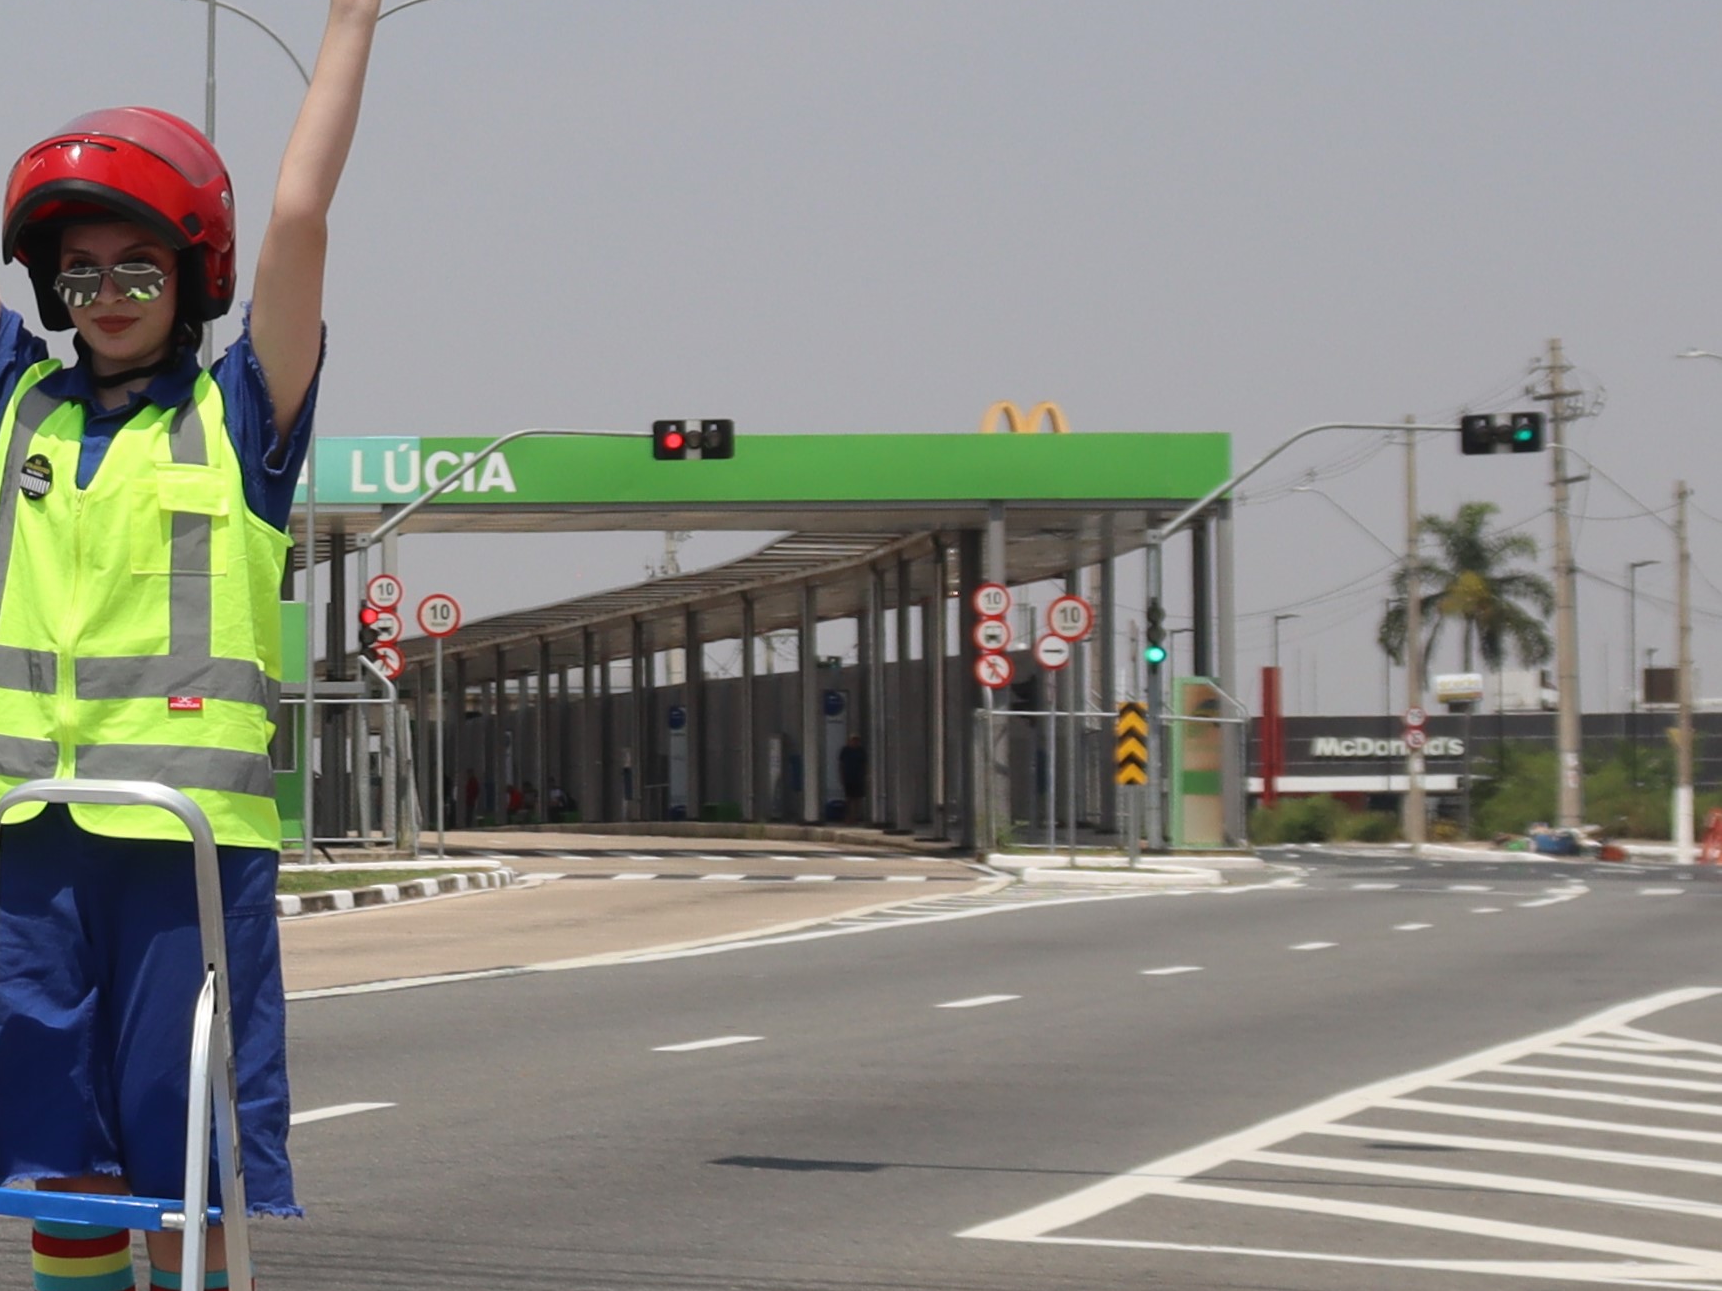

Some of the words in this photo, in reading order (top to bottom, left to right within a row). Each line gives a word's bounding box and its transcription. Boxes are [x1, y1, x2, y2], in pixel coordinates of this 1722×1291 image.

[352, 443, 516, 493] LÚCIA
[377, 582, 395, 596] 10
[984, 592, 1003, 605] 10
[429, 604, 451, 620] 10
[1059, 606, 1081, 623] 10
[1314, 736, 1465, 756] McDond's
